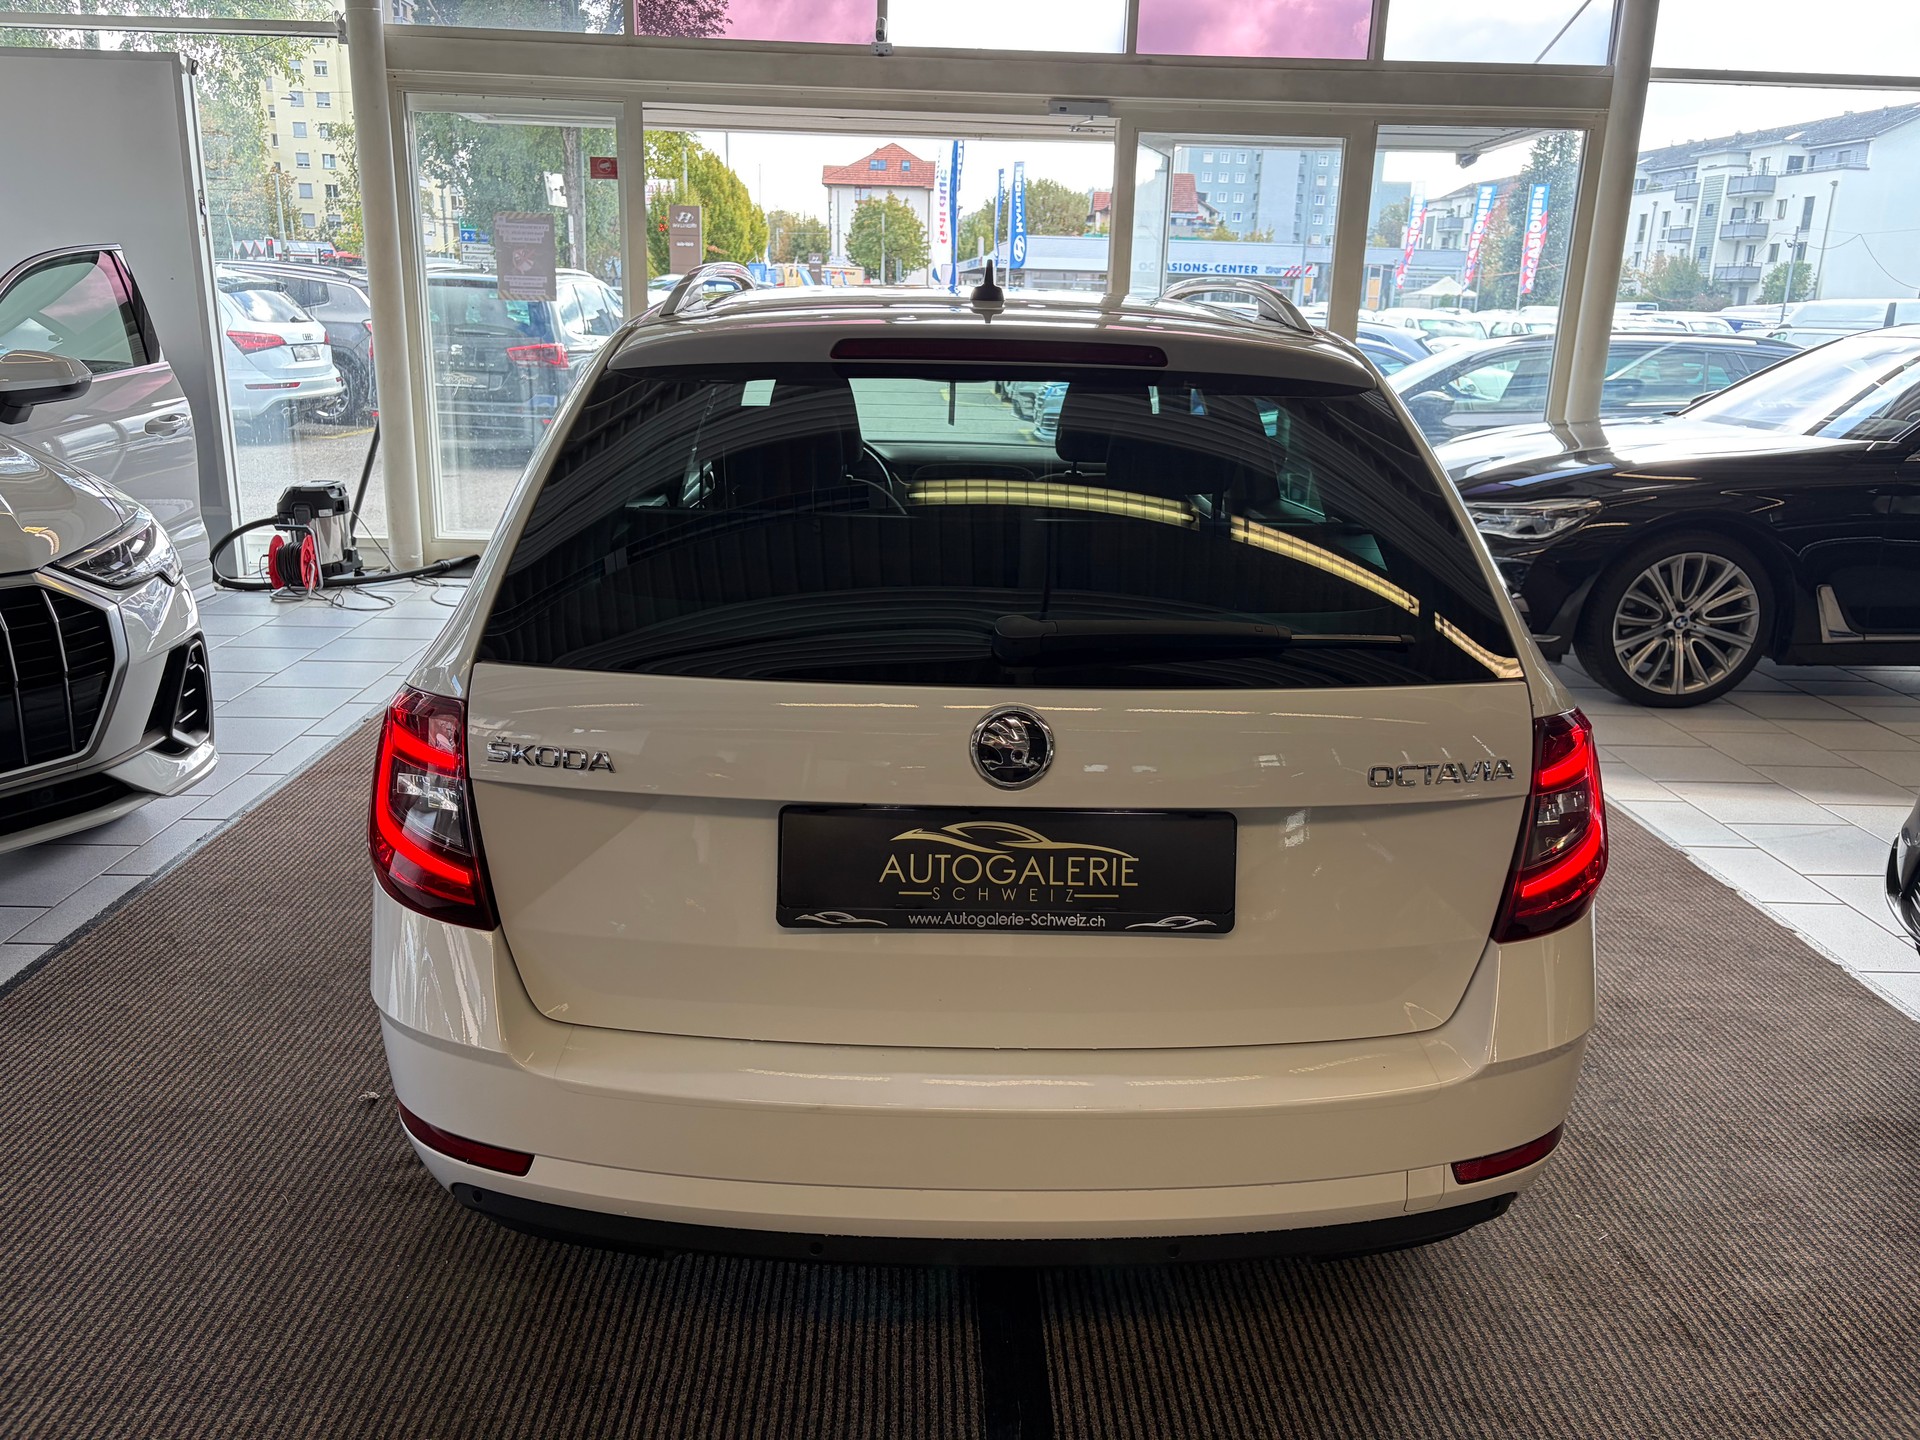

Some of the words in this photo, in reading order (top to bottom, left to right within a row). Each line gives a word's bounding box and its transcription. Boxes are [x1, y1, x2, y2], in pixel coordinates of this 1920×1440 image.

[1525, 186, 1546, 290] OCCASIONEN
[1139, 262, 1258, 274] OCASIONS-CENTER
[487, 736, 616, 773] ŠKODA
[1368, 759, 1515, 788] OCTAVIA
[878, 853, 1139, 887] AUTOGALERIE
[932, 887, 1074, 903] SCHWEIZ
[908, 911, 1106, 928] www.Autogalerie-Schweiz.ch
